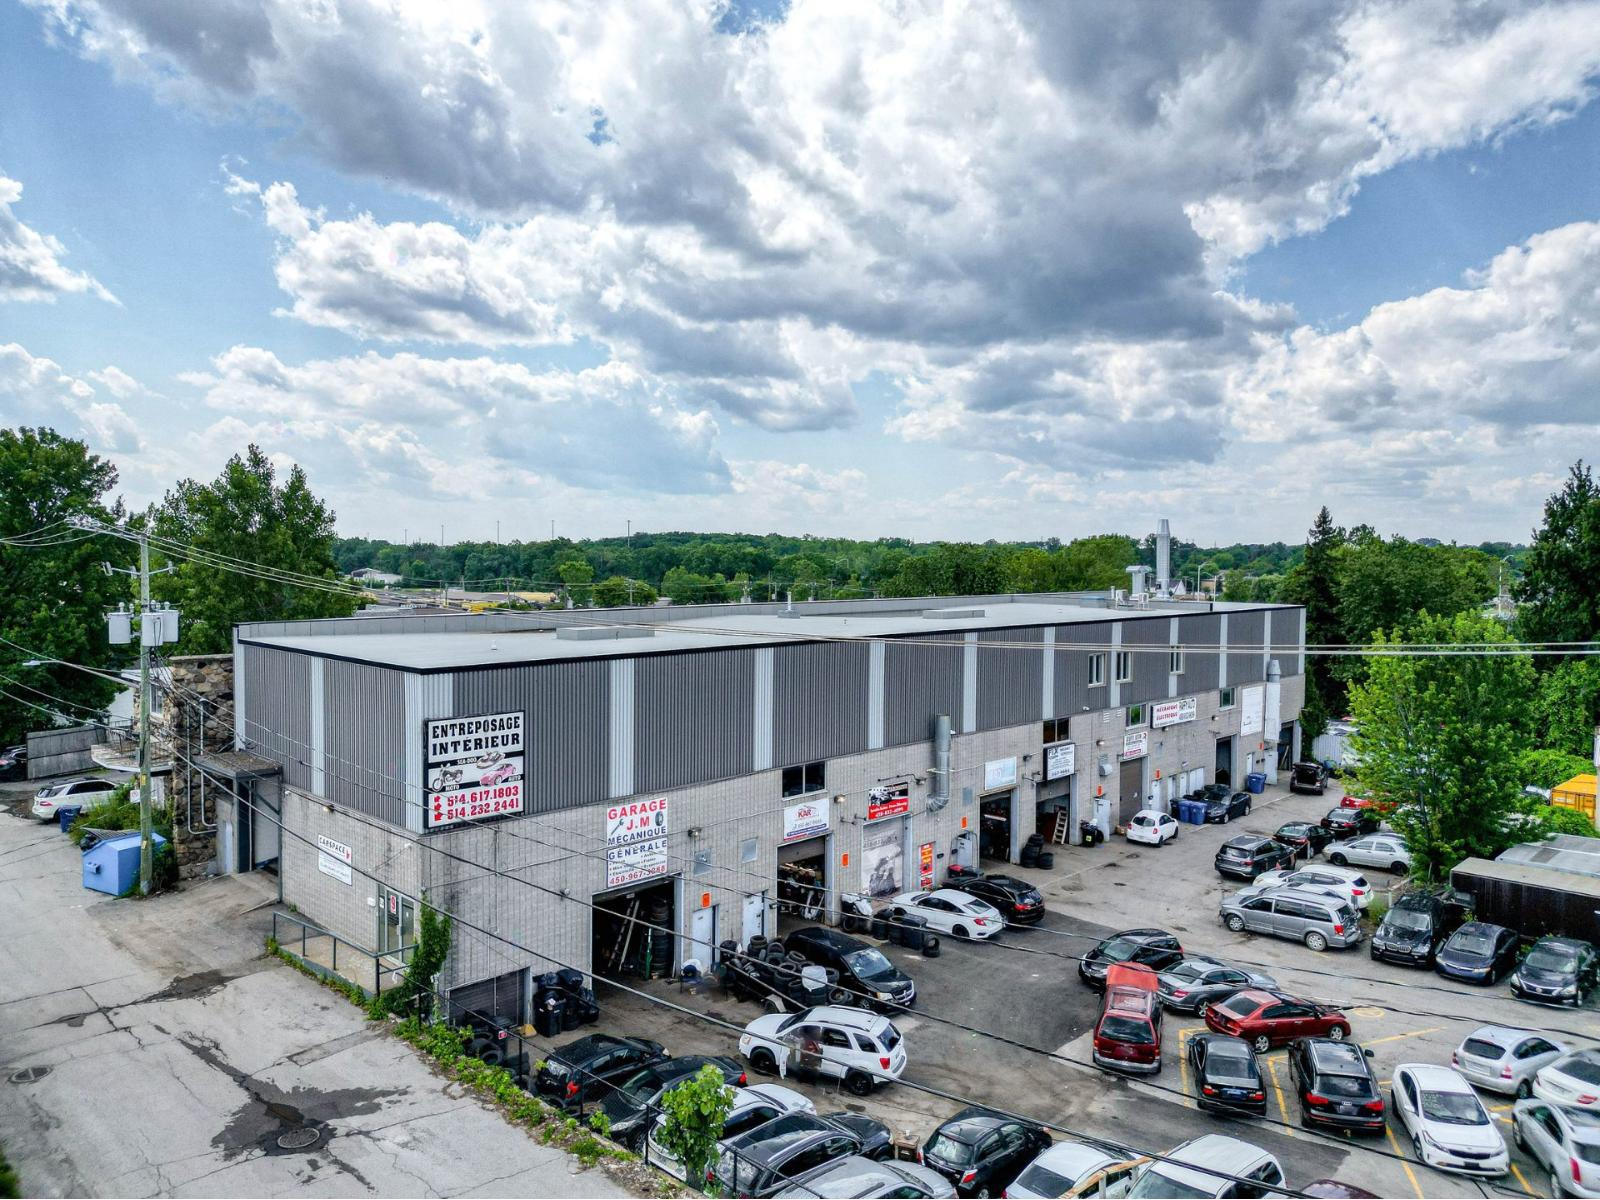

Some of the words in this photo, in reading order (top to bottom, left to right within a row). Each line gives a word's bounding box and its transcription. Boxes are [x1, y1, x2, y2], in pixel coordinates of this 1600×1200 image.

[432, 716, 520, 739] ENTREPOSAGE
[447, 785, 519, 807] 514.617.1803
[447, 798, 519, 820] 514.232.2441
[608, 799, 667, 820] GARAGE
[626, 816, 650, 831] J.M
[607, 826, 667, 846] MÉCANIQUE
